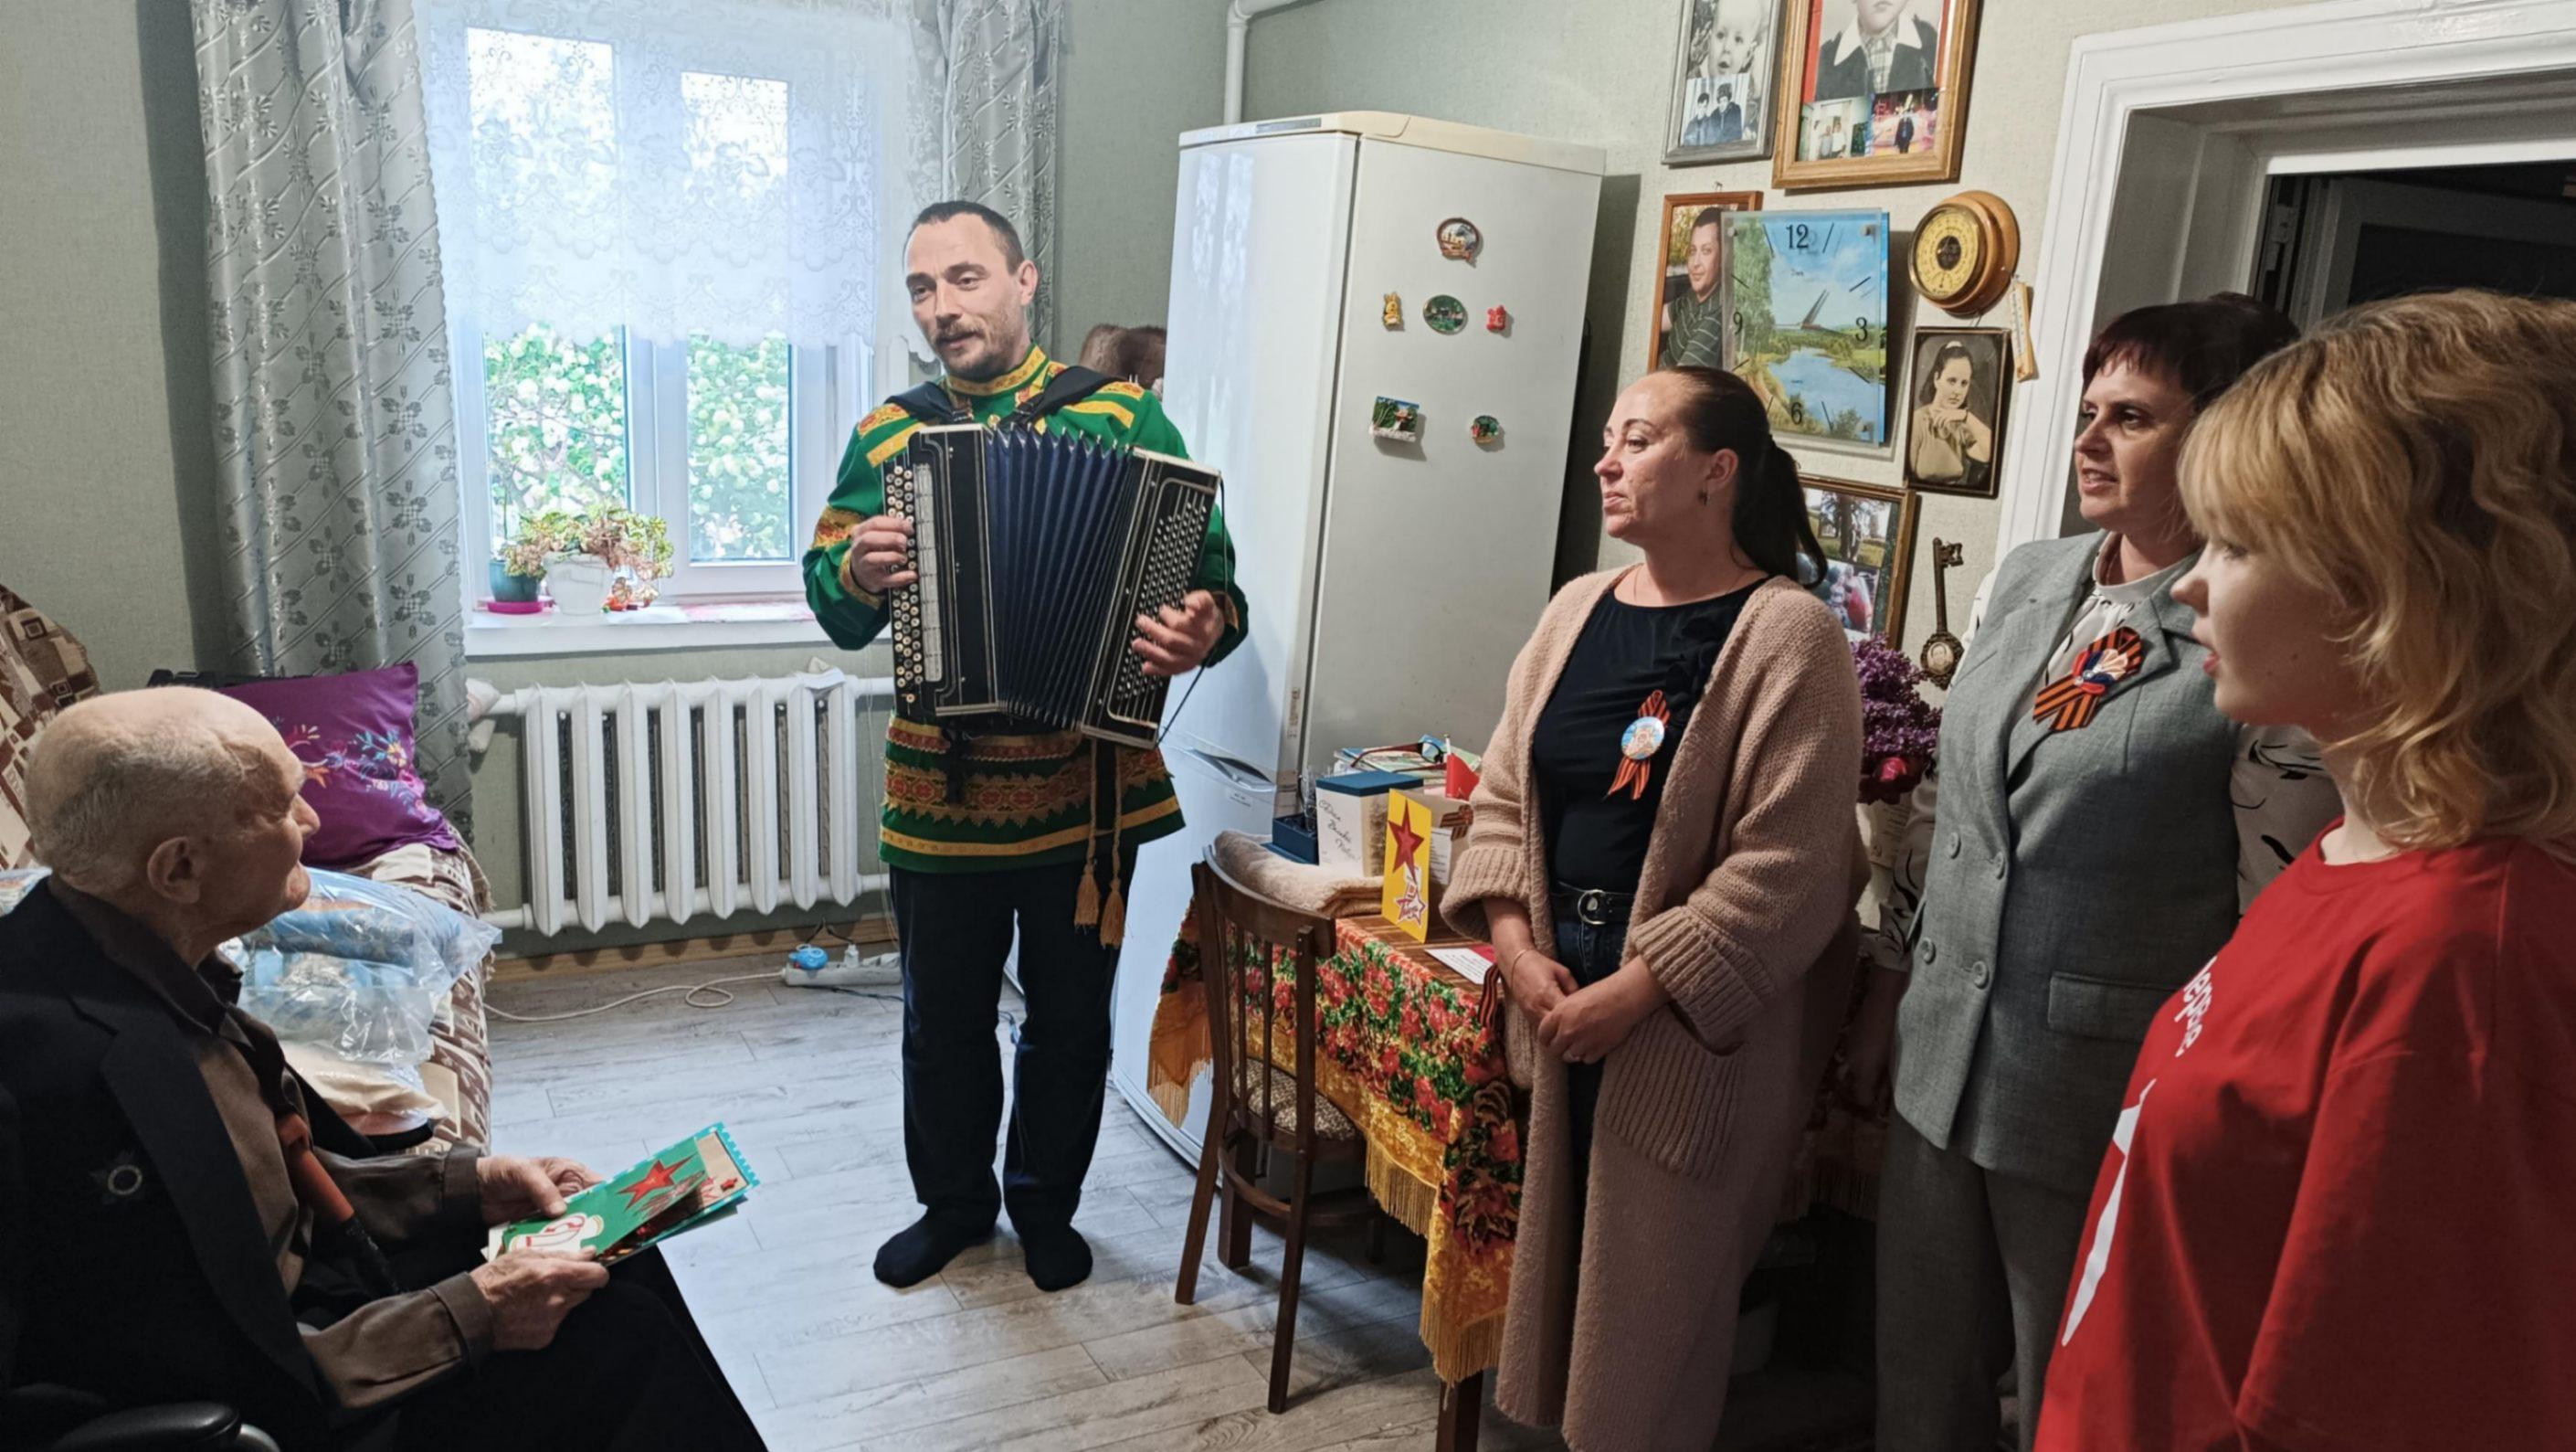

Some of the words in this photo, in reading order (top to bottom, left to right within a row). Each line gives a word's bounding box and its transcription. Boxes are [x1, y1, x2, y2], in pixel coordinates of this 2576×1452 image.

[1786, 223, 1809, 249] 12
[1733, 311, 1743, 335] 9
[1855, 316, 1868, 342] 3
[1790, 401, 1802, 426] 6
